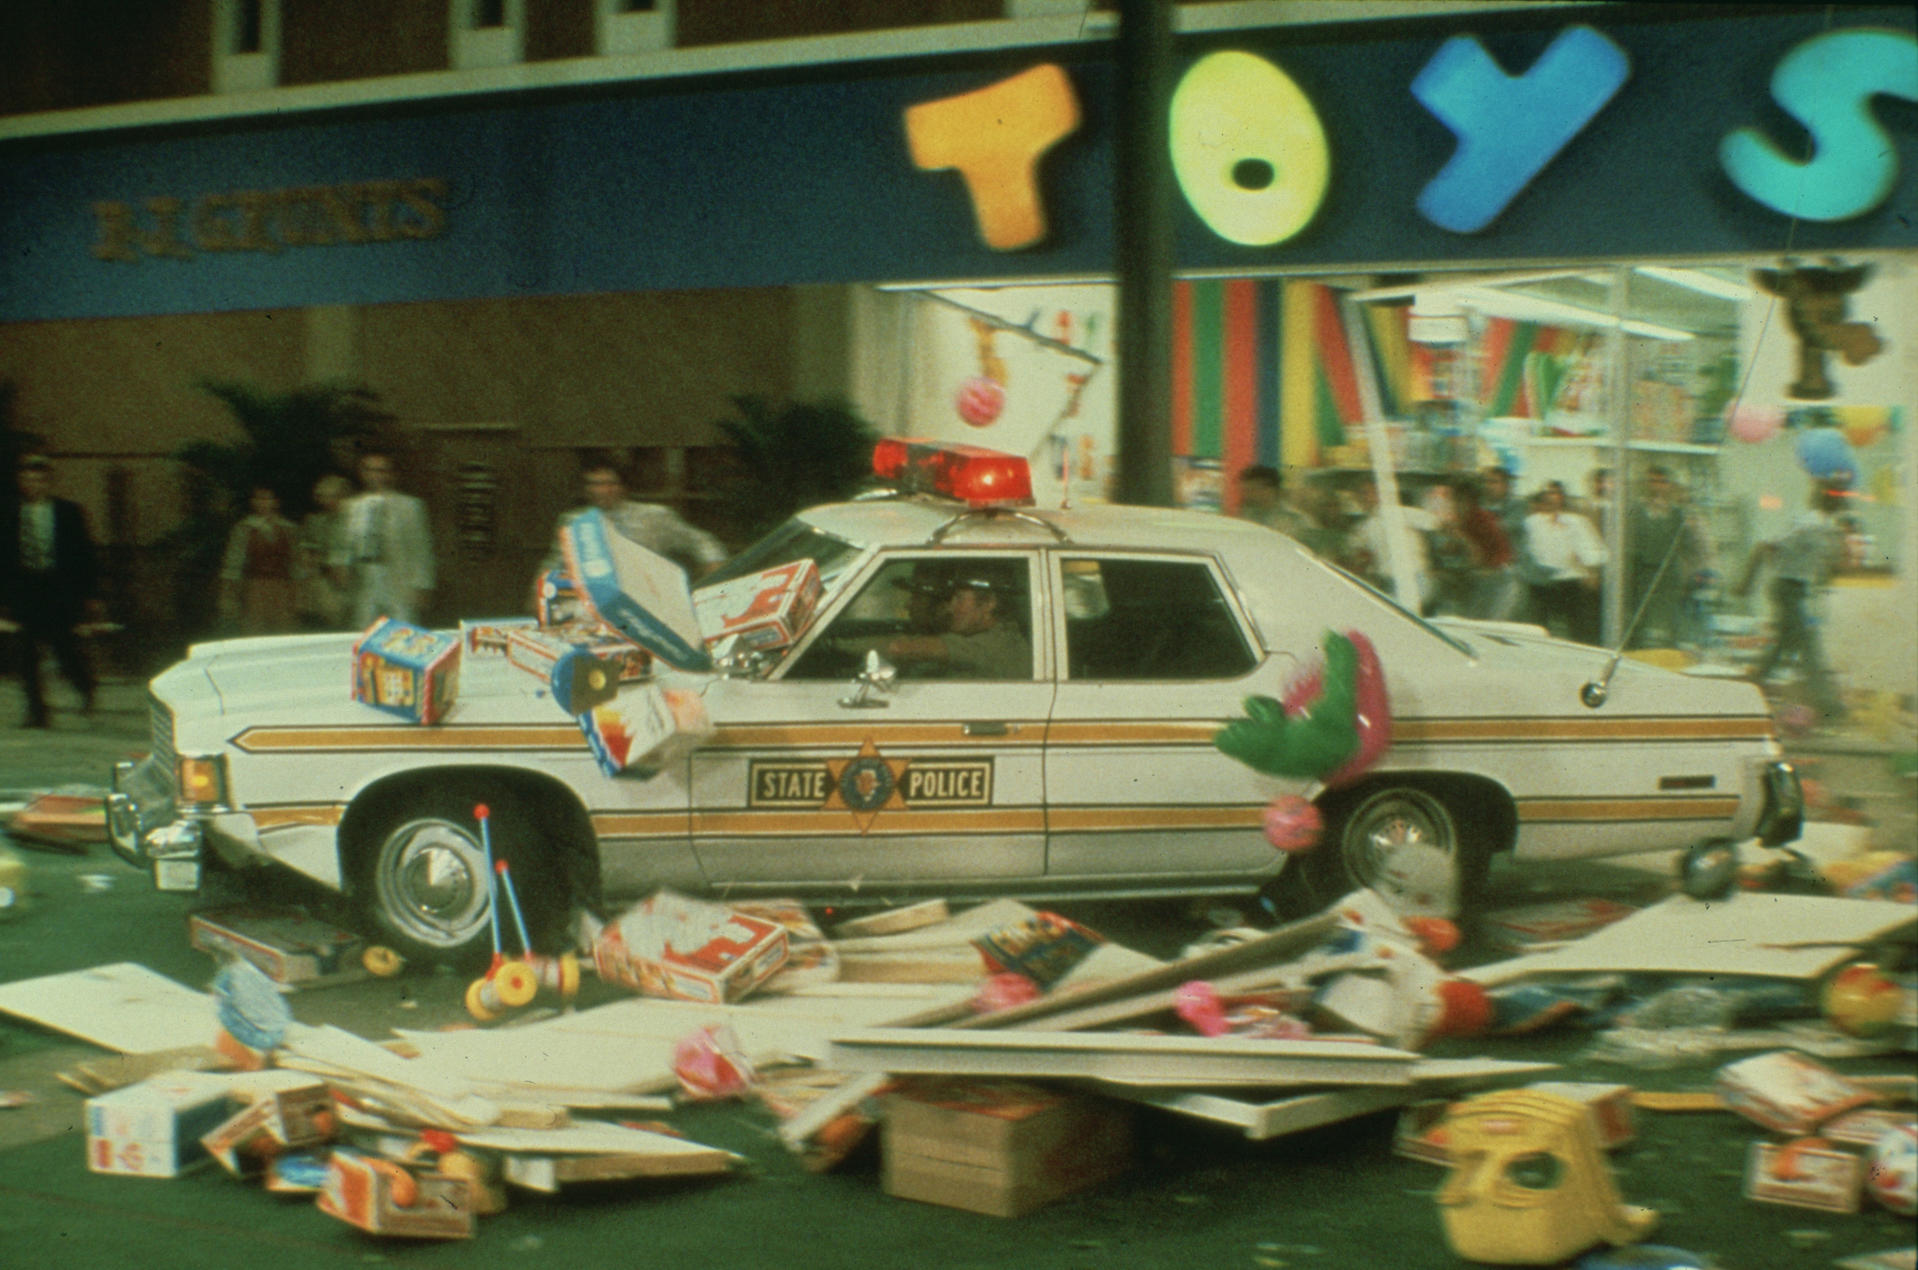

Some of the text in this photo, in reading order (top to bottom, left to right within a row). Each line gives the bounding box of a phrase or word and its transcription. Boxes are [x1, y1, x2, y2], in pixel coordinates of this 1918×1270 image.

[904, 25, 1918, 249] TOYS
[763, 771, 826, 798] STATE
[909, 771, 983, 798] POLICE
